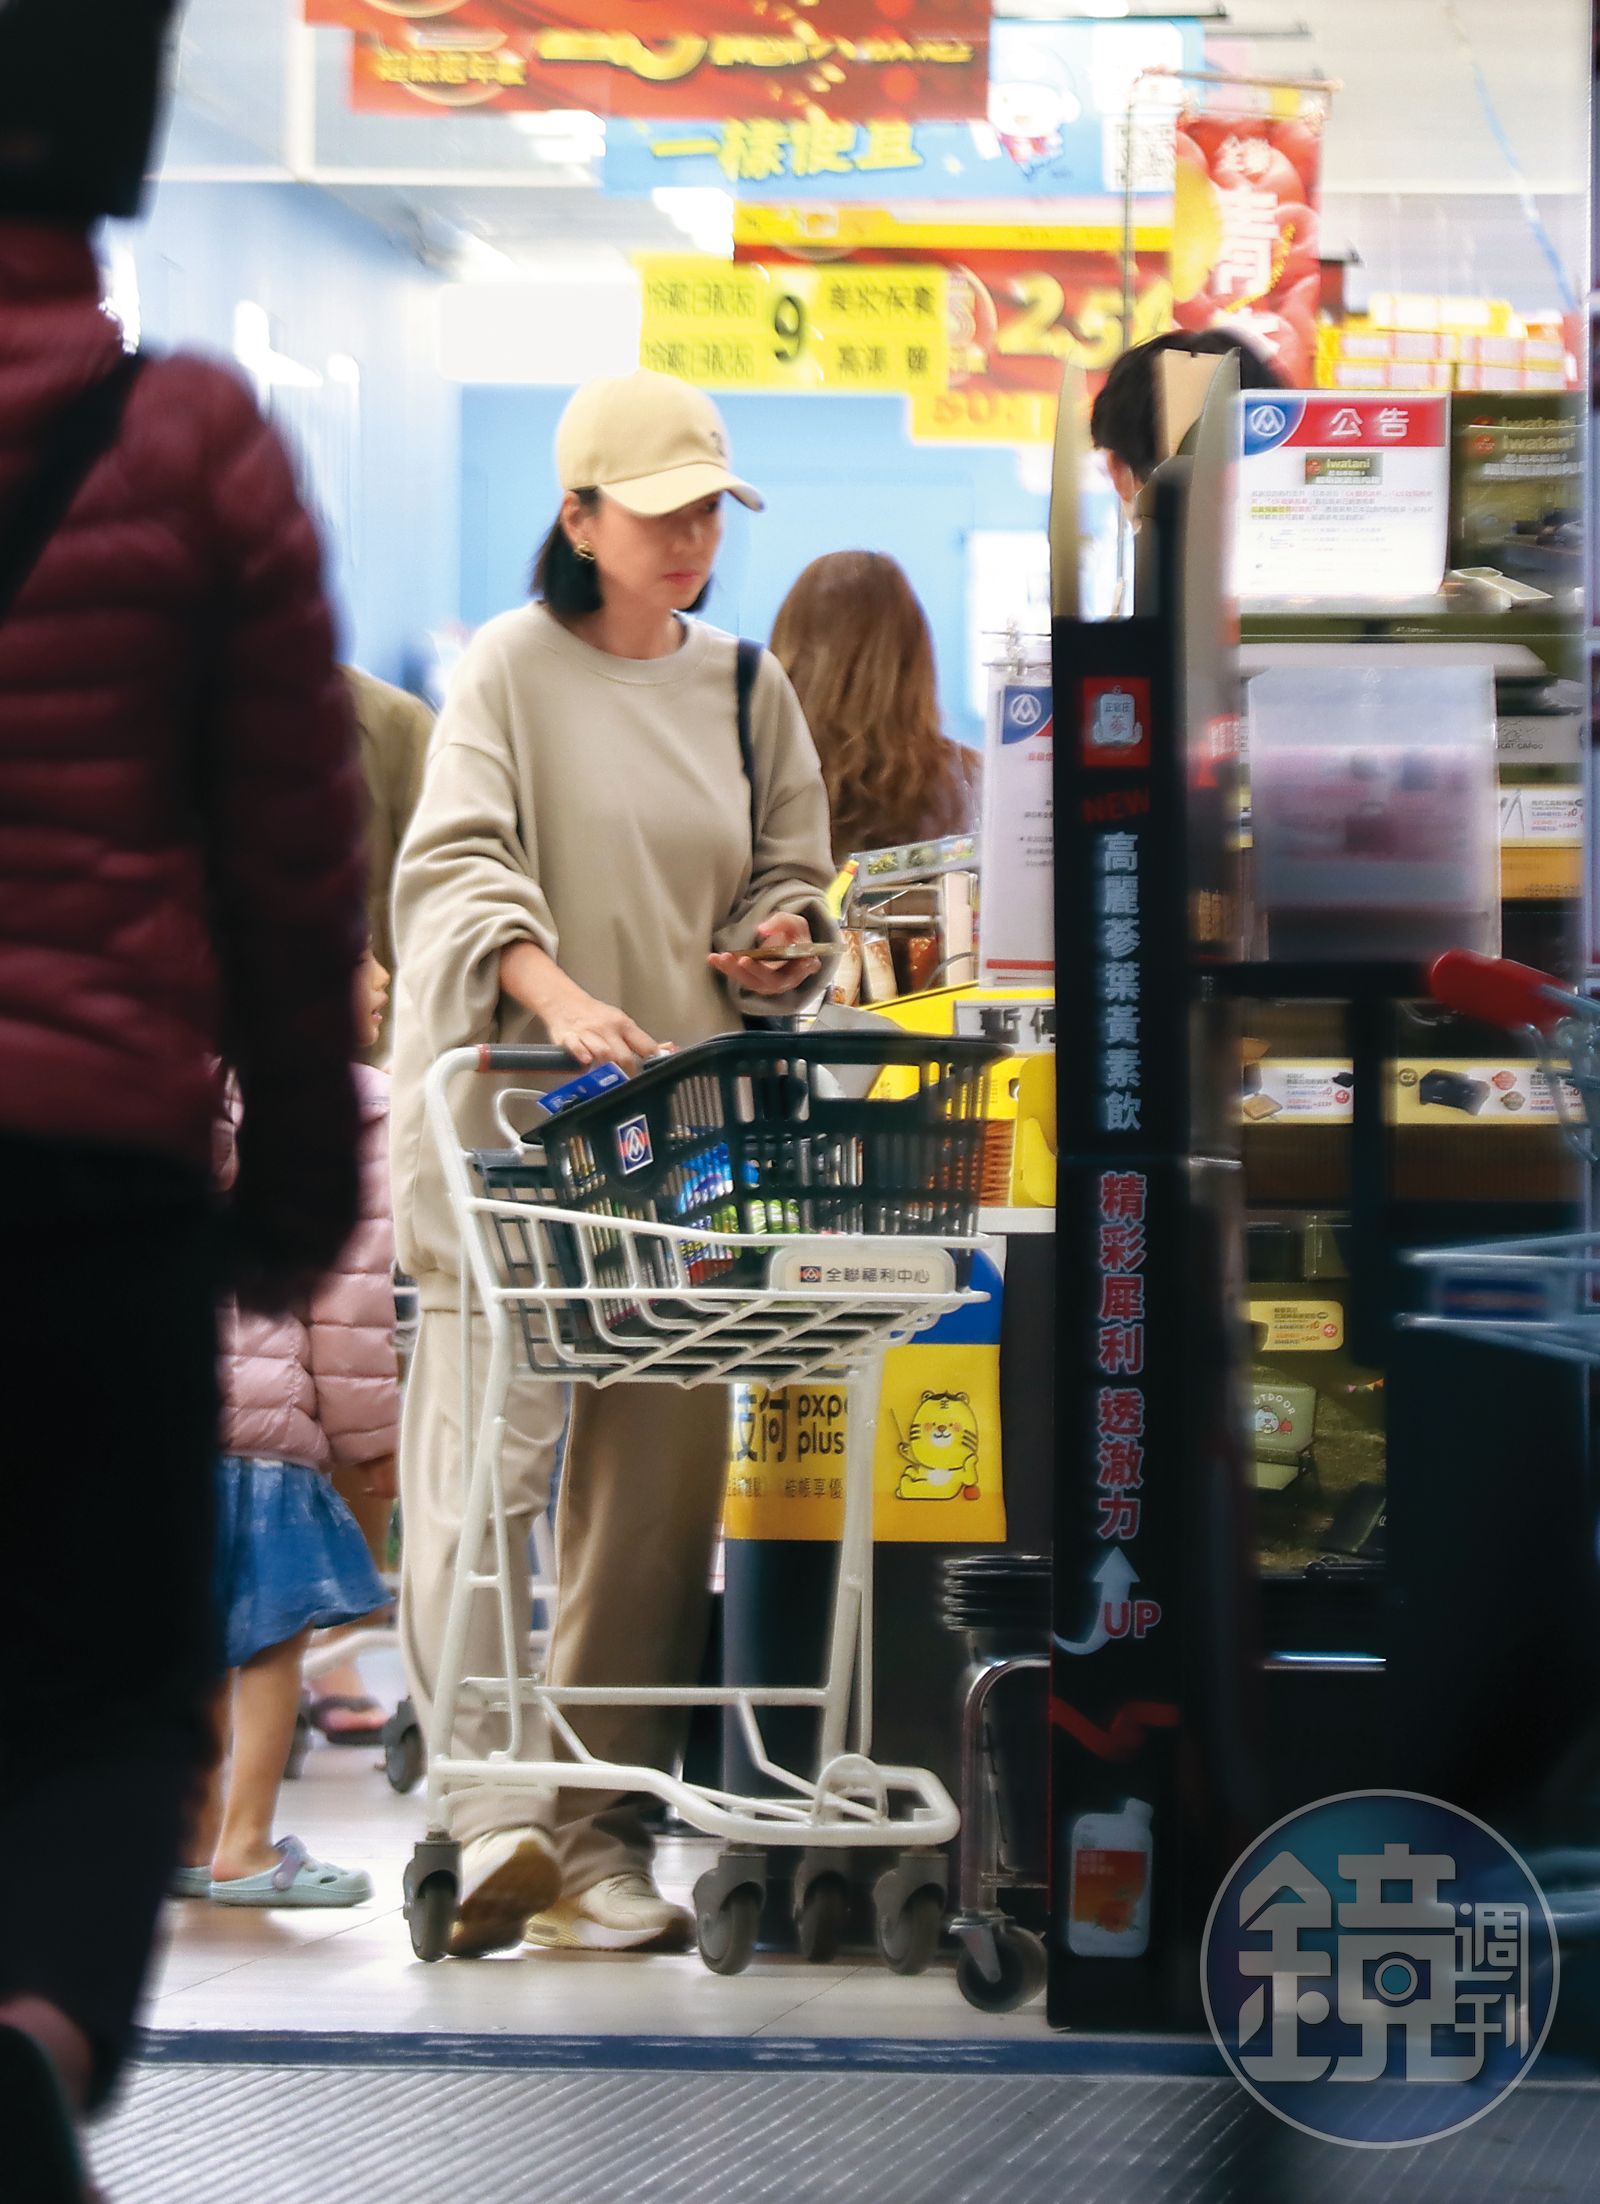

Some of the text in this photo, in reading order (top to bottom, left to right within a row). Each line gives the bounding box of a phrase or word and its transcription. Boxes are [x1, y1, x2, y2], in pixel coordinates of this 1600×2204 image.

[774, 294, 803, 363] 9
[1330, 406, 1410, 438] 公告
[826, 1267, 930, 1284] 全聯福利中心
[1098, 1172, 1147, 1375] 精彩犀利
[1253, 1392, 1296, 1416] UTDOOR
[797, 1421, 846, 1463] plus
[1102, 1600, 1162, 1638] UP
